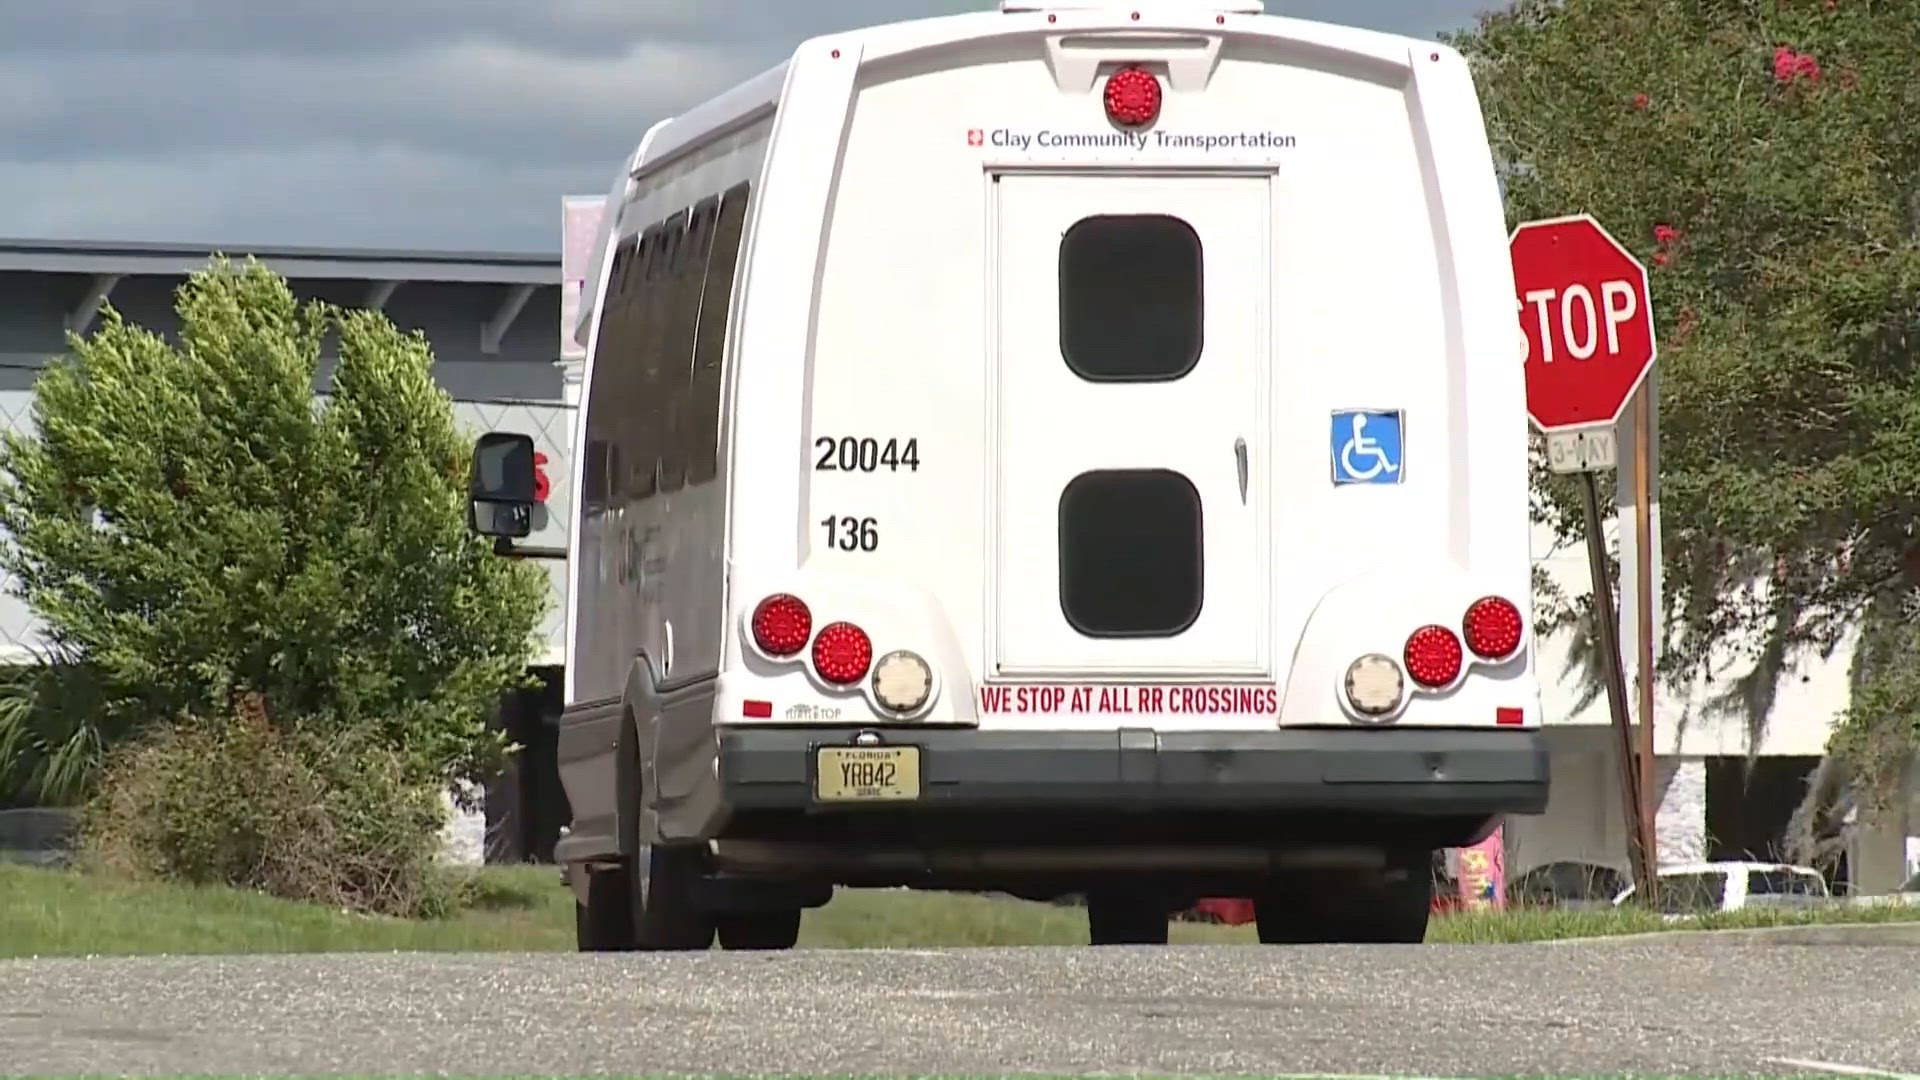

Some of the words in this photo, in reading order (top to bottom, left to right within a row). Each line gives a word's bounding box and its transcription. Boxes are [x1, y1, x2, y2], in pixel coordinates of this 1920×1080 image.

[991, 129, 1031, 150] Clay
[1037, 129, 1147, 151] Community
[1154, 130, 1296, 151] Transportation
[815, 436, 920, 473] 20044
[821, 514, 879, 552] 136
[981, 687, 1011, 712] WE
[1017, 687, 1065, 712] STOP
[1071, 687, 1093, 712] AT
[1098, 687, 1133, 712] ALL
[1138, 687, 1164, 712] RR
[1168, 687, 1278, 713] CROSSINGS
[845, 751, 891, 759] FLORIDA
